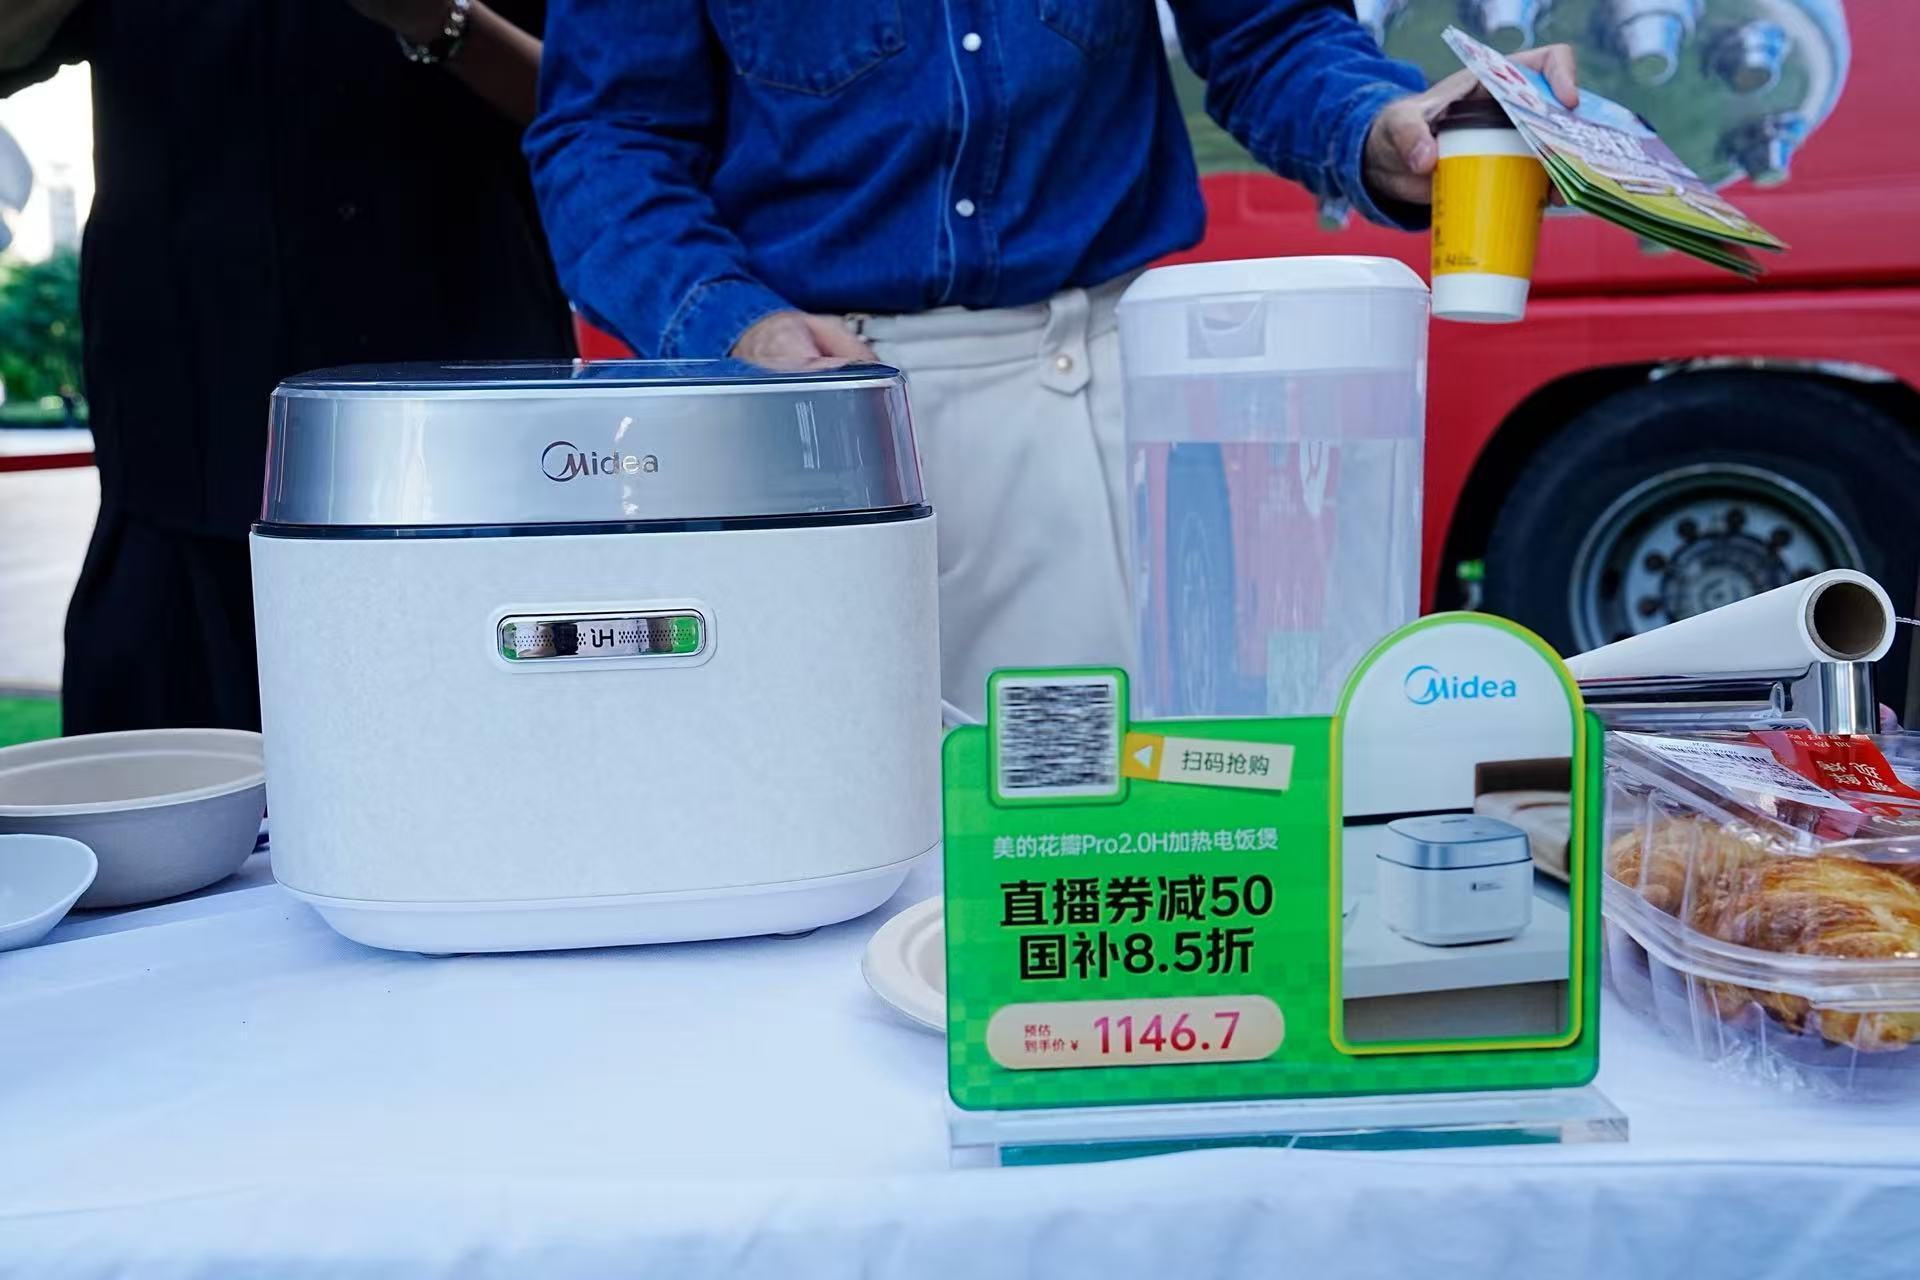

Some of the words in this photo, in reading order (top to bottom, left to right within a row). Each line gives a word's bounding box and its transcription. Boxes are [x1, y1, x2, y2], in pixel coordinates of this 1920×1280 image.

[541, 440, 659, 482] Midea
[1404, 665, 1517, 705] Midea
[1181, 750, 1270, 776] 扫码抢购
[1000, 873, 1273, 927] 直播券减50
[1020, 927, 1255, 980] 国补8.5折
[1093, 1011, 1241, 1054] 1146.7
